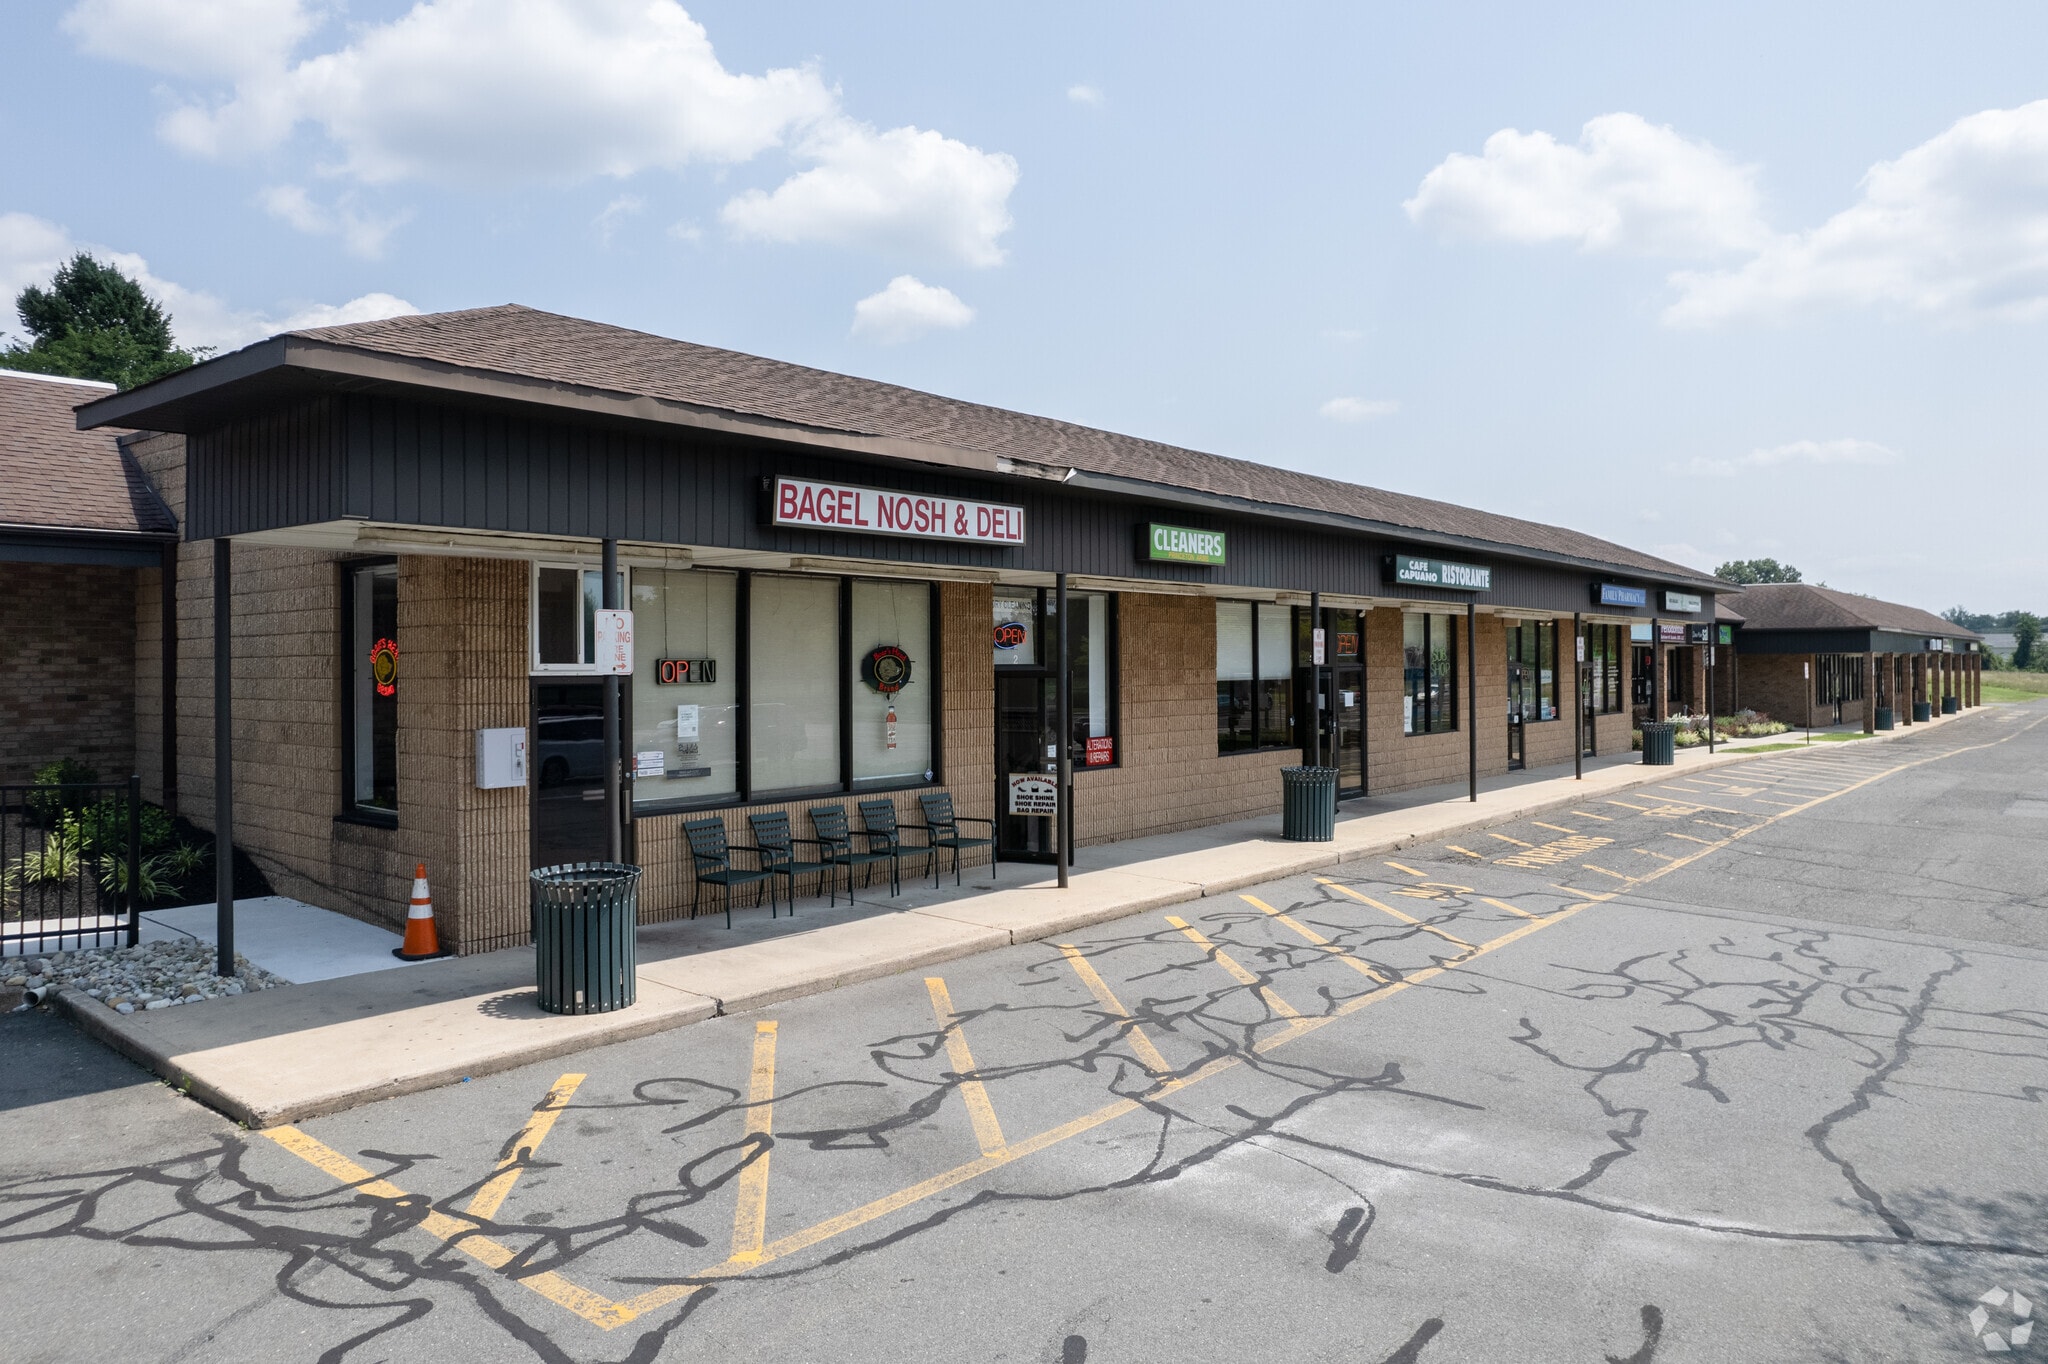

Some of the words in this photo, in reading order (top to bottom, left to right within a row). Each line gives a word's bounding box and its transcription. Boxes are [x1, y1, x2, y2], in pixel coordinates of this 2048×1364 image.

[779, 483, 868, 527] BAGEL
[877, 495, 946, 534] NOSH
[953, 504, 969, 536] &
[977, 506, 1022, 540] DELI
[1154, 528, 1222, 557] CLEANERS
[1409, 560, 1428, 572] CAFE
[1399, 569, 1438, 583] CAPUANO
[1441, 564, 1490, 588] RISTORANTE
[993, 627, 1027, 645] OPEN
[1013, 654, 1019, 665] 2
[1432, 647, 1448, 662] SUB
[661, 660, 716, 683] OPEN
[1430, 662, 1451, 678] SHOP
[1011, 777, 1025, 788] NOW
